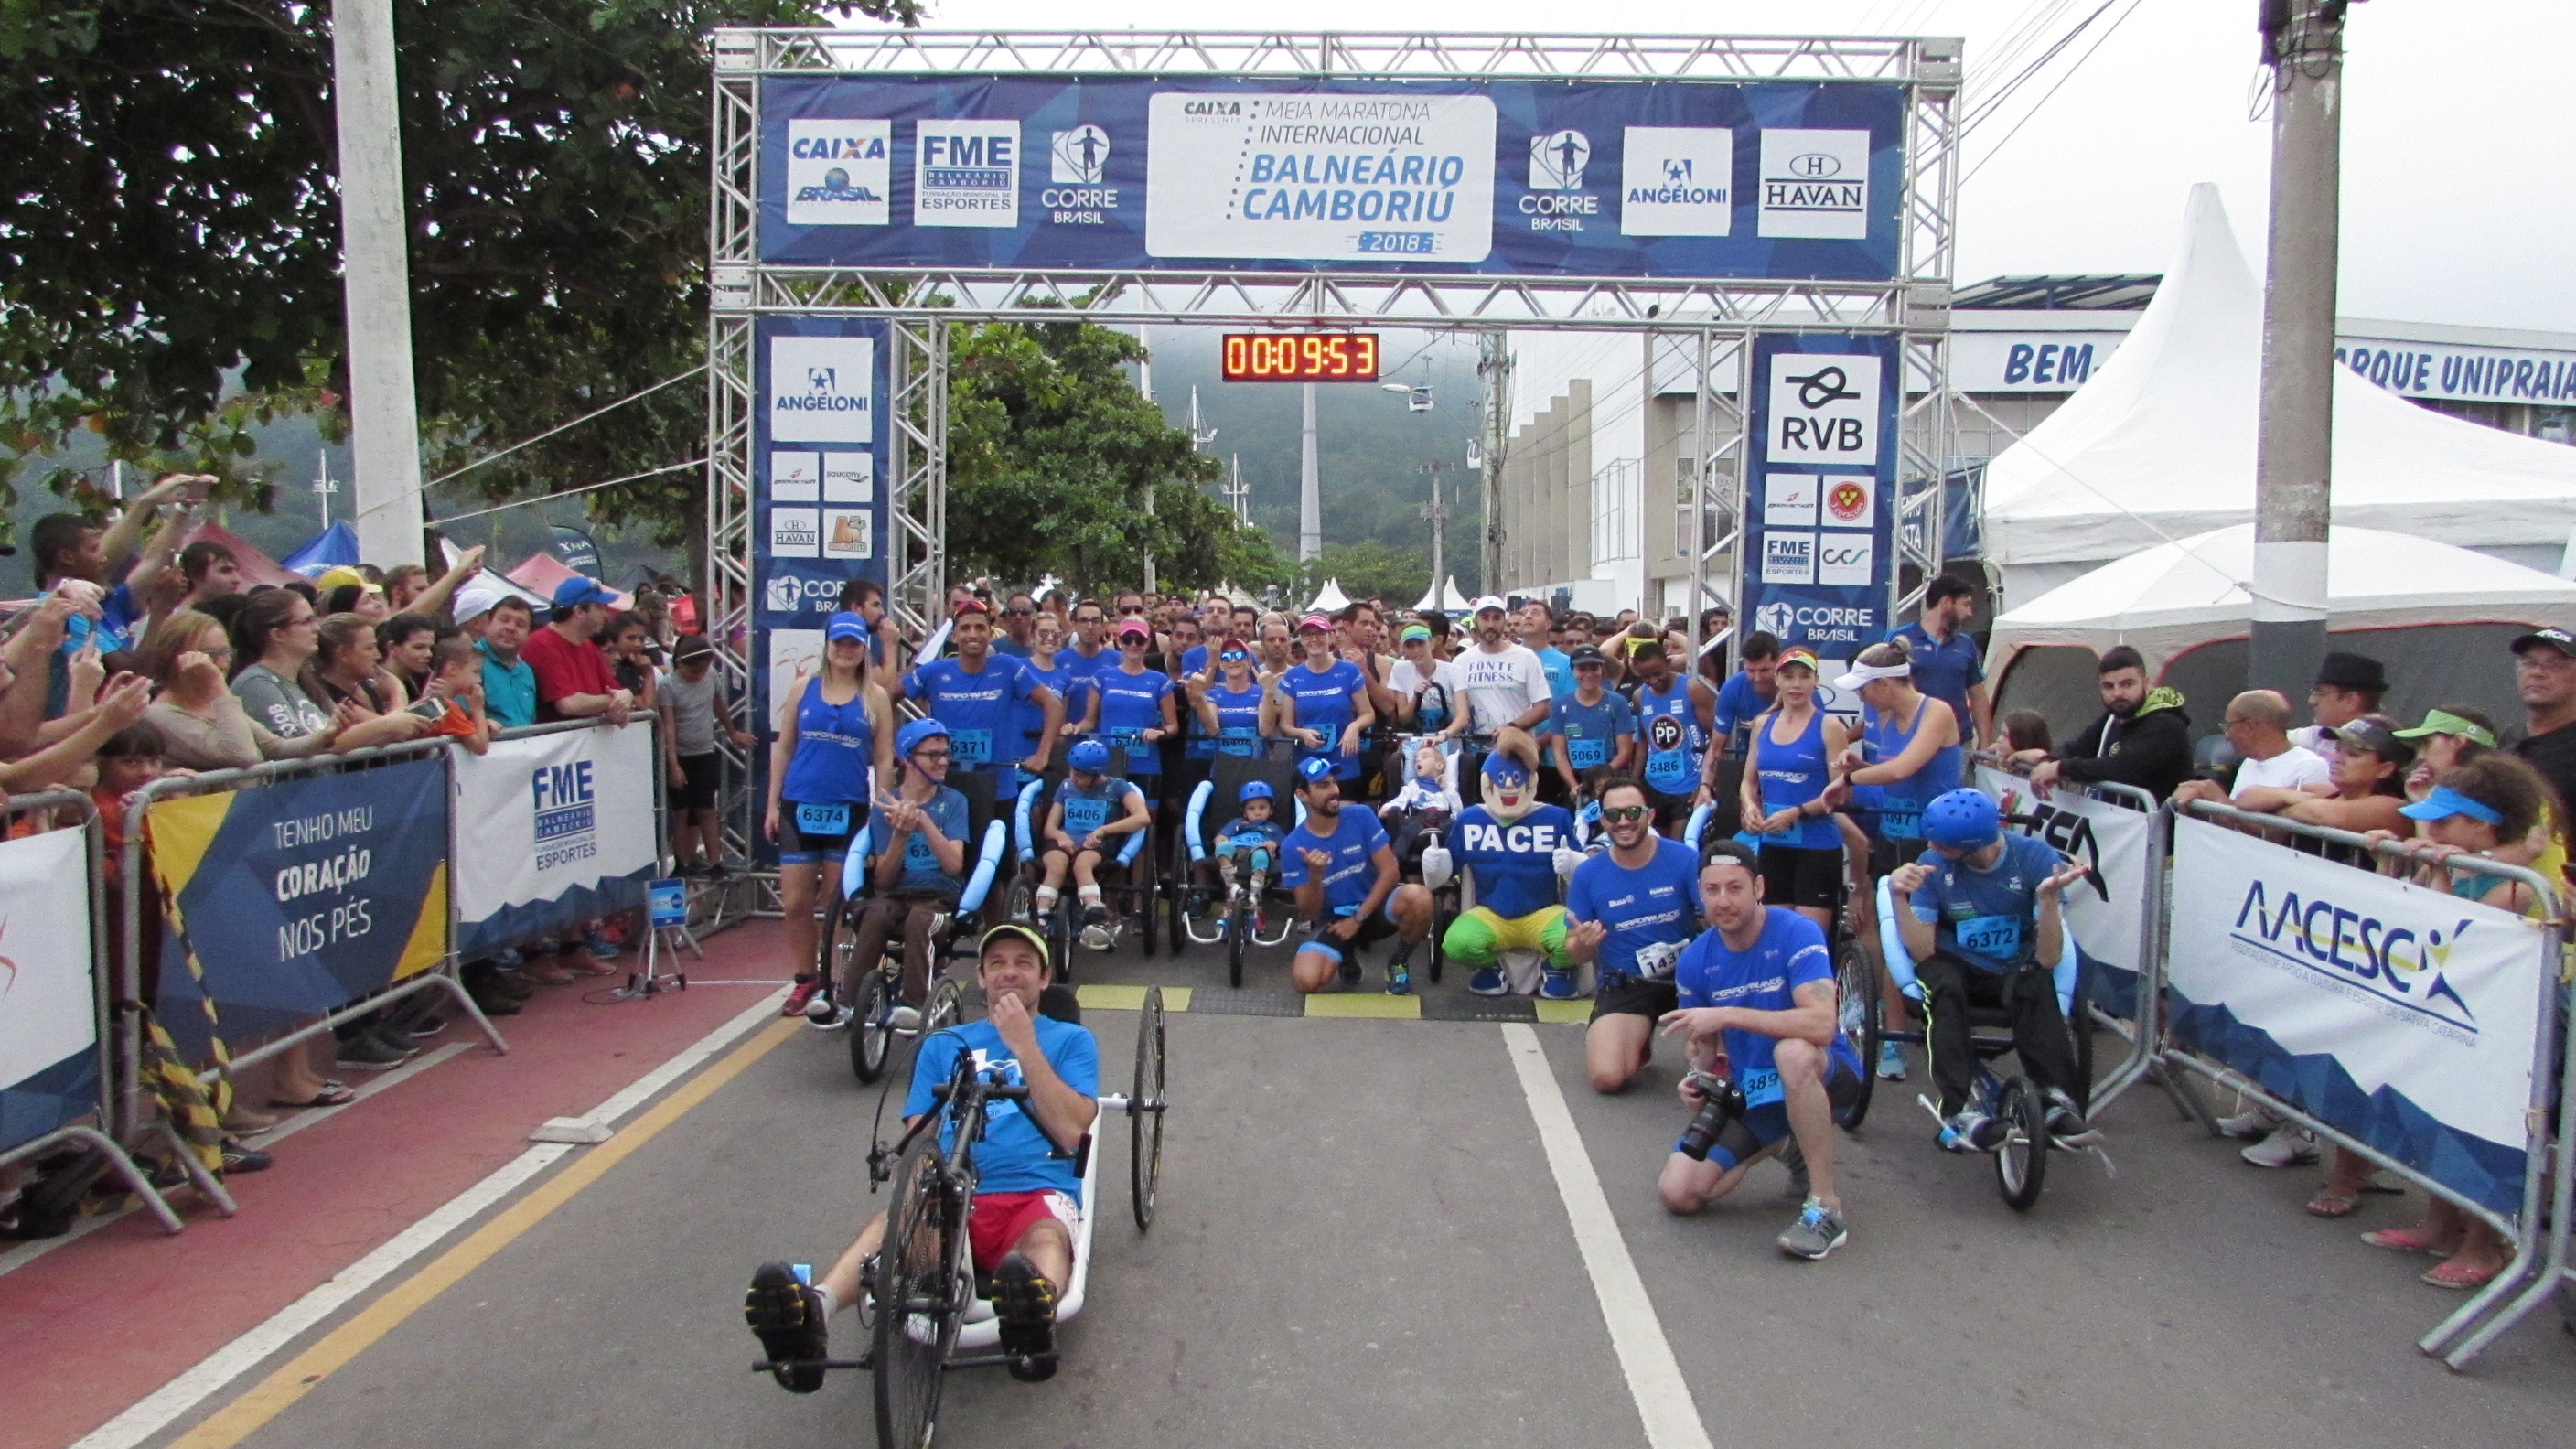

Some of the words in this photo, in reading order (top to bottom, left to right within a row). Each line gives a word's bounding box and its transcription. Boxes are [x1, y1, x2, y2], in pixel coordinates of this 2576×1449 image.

[1184, 102, 1241, 115] CAIXA
[1265, 102, 1314, 120] MEIA
[1320, 102, 1431, 121] MARATONA
[1261, 125, 1424, 145] INTERNACIONAL
[793, 138, 885, 160] CAIXA
[924, 136, 1012, 166] FME
[1250, 148, 1464, 184] BALNEÁRIO
[1806, 157, 1823, 174] H
[795, 186, 883, 201] BRASIL
[1042, 188, 1118, 209] CORRE
[1627, 188, 1727, 204] ANGELONI
[1766, 185, 1863, 206] HAVAN
[922, 198, 1011, 209] ESPORTES
[1519, 196, 1598, 214] CORRE
[1054, 212, 1104, 224] BRASIL
[1531, 218, 1583, 231] BRASIL
[1370, 234, 1420, 251] 2018
[1227, 338, 1374, 374] 00:09:53
[2441, 355, 2576, 401] UNIPRAIA
[777, 395, 868, 412] ANGELONI
[1781, 416, 1863, 452] RVB
[826, 470, 862, 478] saucony
[776, 533, 815, 543] HAVAN
[1767, 540, 1810, 555] FME
[1766, 568, 1809, 576] ESPORTES
[1796, 606, 1873, 627] CORRE
[1807, 628, 1858, 642] BRASIL
[1469, 661, 1515, 672] FONTE
[1467, 671, 1514, 683] FITNESS
[1655, 726, 1677, 743] PP
[950, 741, 986, 754] 6371
[1572, 750, 1601, 761] 5069
[1649, 760, 1680, 773] 5486
[532, 760, 594, 810] FME
[803, 808, 843, 823] 6374
[1068, 808, 1100, 821] 6406
[274, 814, 333, 849] TENHO
[338, 805, 373, 837] MEU
[1464, 825, 1555, 853] PACE
[536, 842, 596, 871] ESPORTES
[910, 844, 930, 858] 63
[277, 844, 370, 902] CORAÇÃO
[279, 914, 326, 962] NOS
[332, 895, 372, 944] PÉS
[1967, 928, 2014, 949] 6372
[1743, 1072, 1779, 1095] 389
